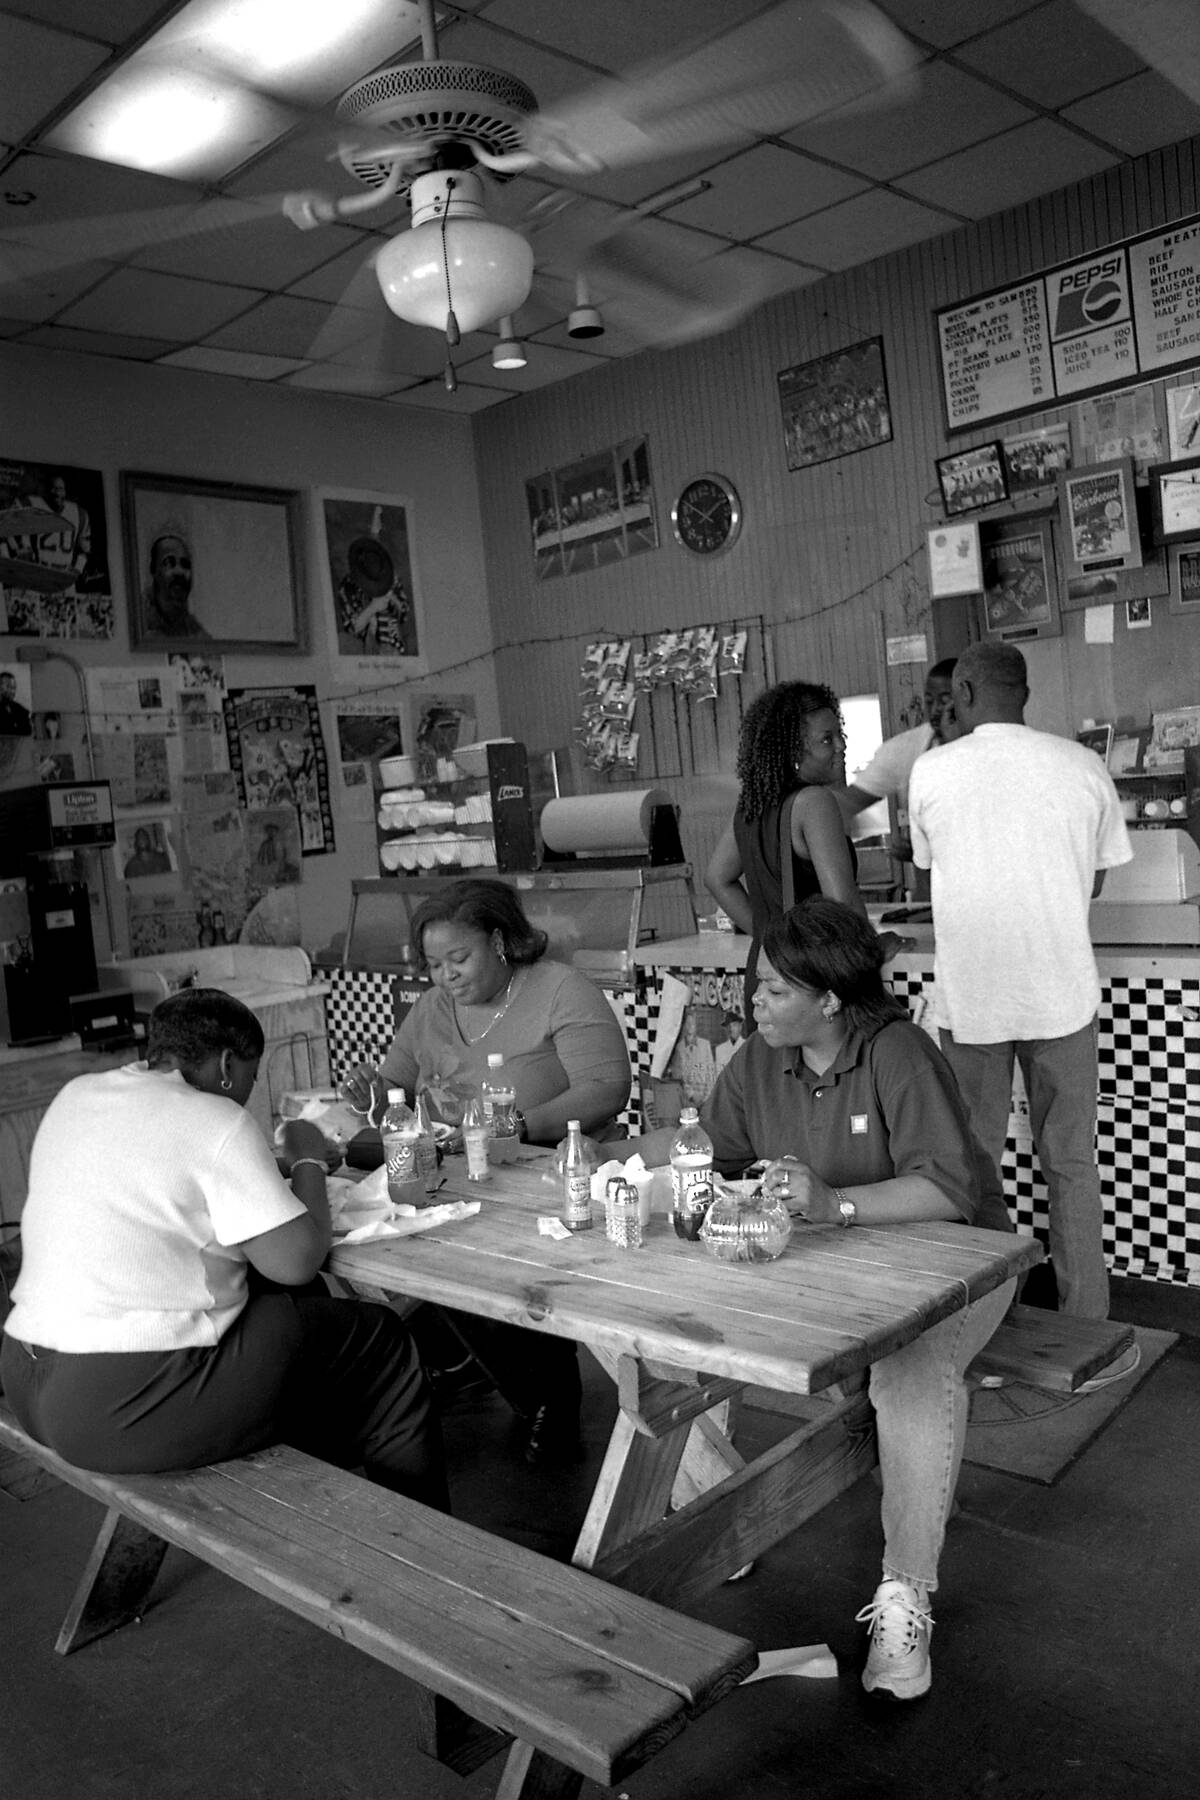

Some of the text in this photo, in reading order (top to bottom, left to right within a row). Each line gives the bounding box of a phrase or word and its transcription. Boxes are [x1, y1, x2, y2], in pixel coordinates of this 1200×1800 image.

[1163, 226, 1200, 248] MEAT
[1148, 250, 1174, 265] BEEF
[1059, 257, 1122, 293] PEPSI
[1149, 263, 1168, 275] RIB
[1150, 266, 1193, 286] MUTTON
[984, 301, 994, 309] TO
[1154, 304, 1178, 318] HALF
[1062, 340, 1088, 353] SODA
[962, 350, 989, 364] BEANS
[994, 349, 1020, 364] SALAD
[1064, 351, 1087, 364] ICED
[1090, 344, 1110, 355] TEA
[1064, 360, 1091, 374] JUICE
[952, 403, 979, 417] CHIPS
[387, 1145, 412, 1177] slice
